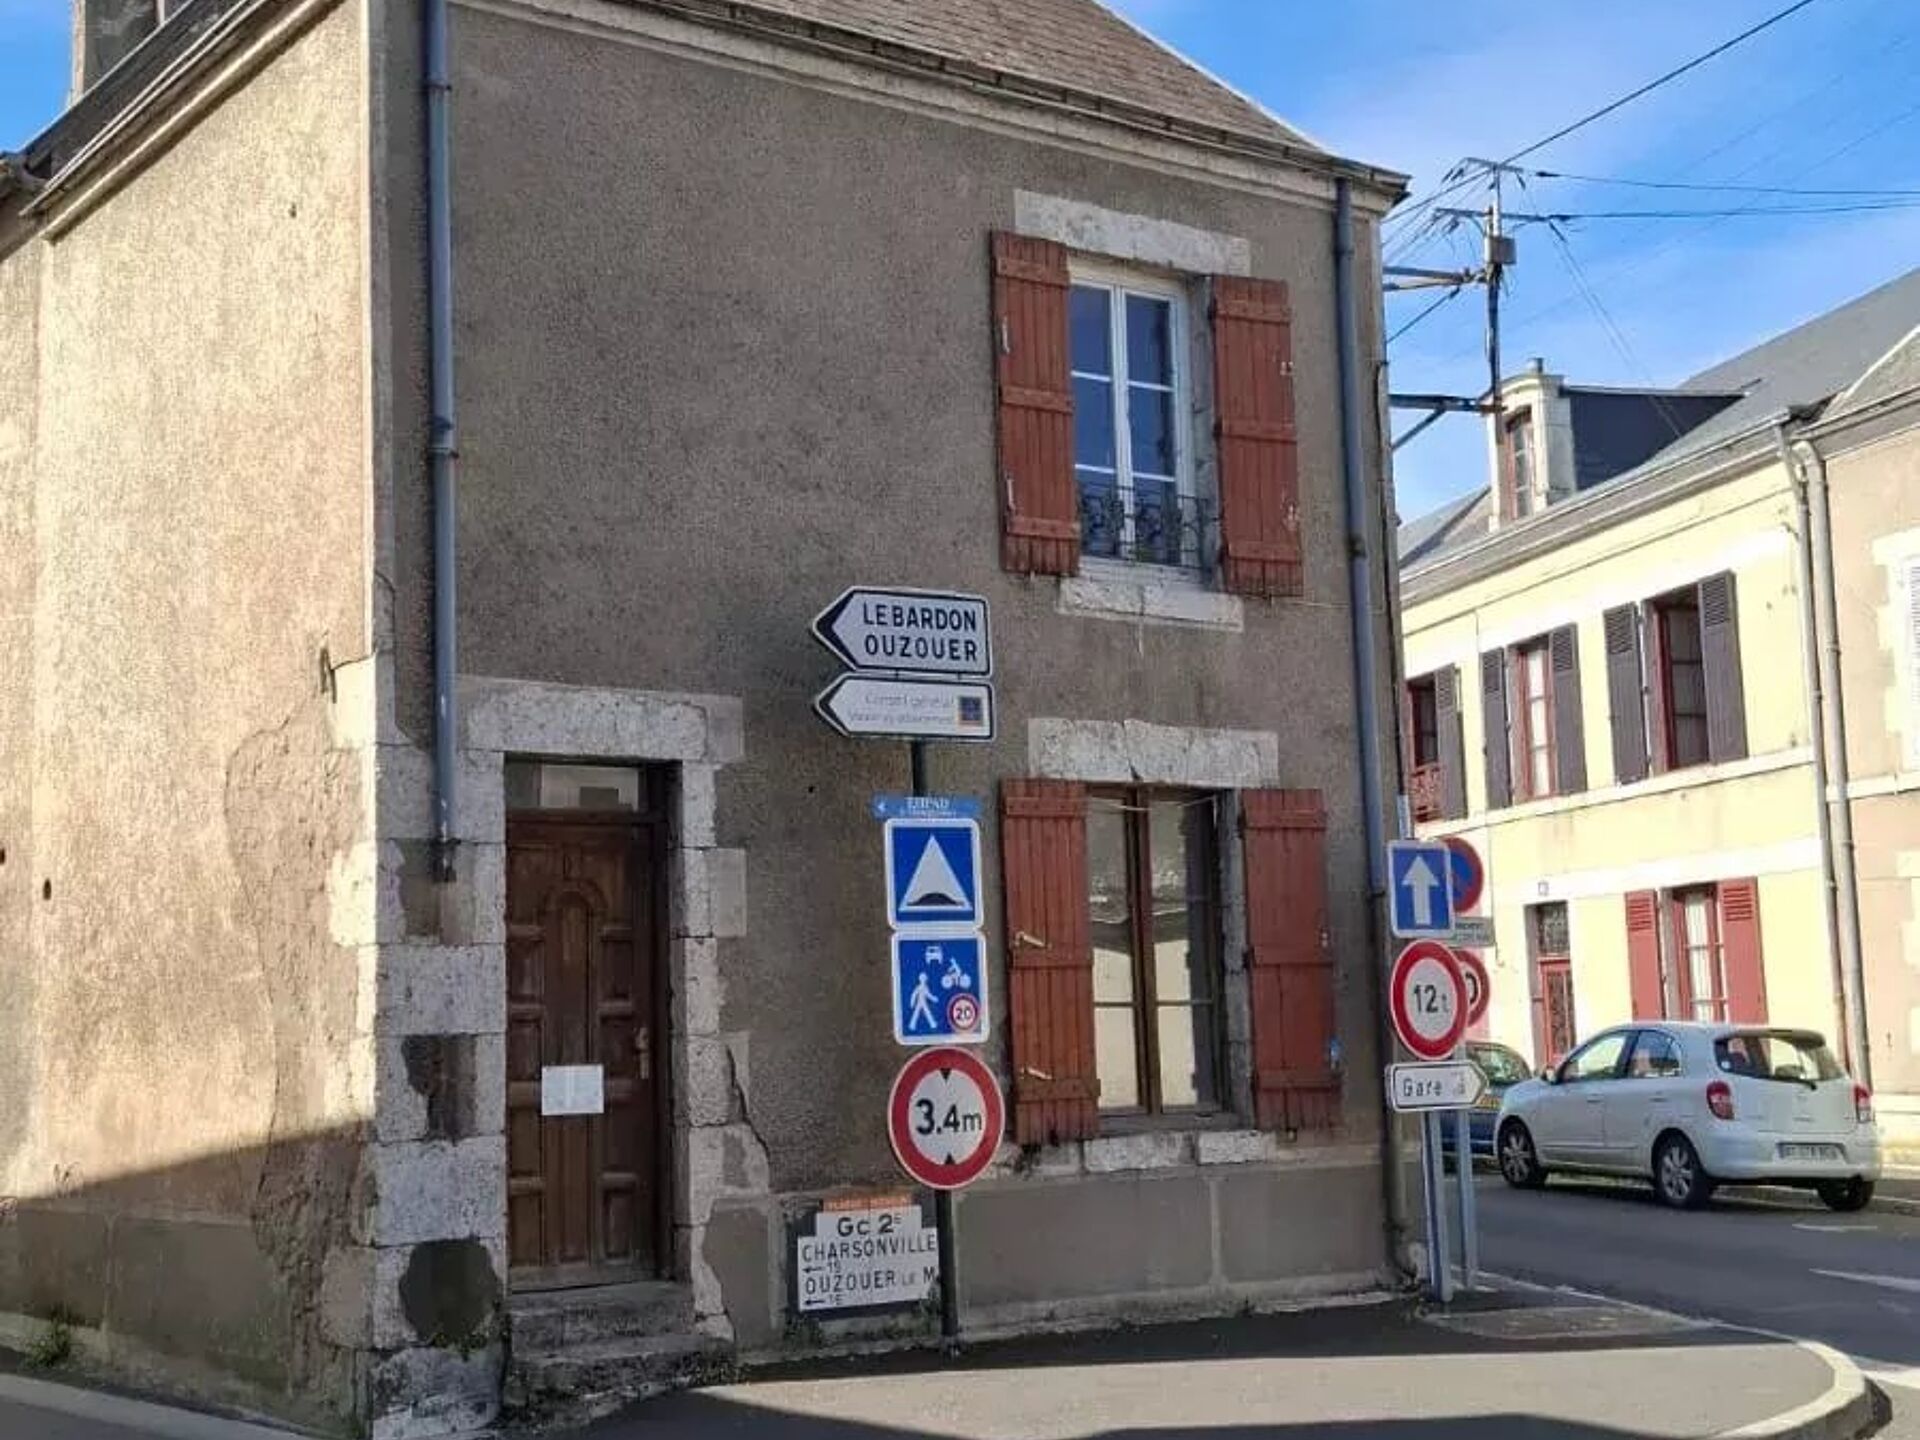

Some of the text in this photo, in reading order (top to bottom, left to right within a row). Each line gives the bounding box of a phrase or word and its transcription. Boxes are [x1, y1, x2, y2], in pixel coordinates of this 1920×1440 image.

[863, 601, 977, 632] LE BARDON
[864, 634, 978, 662] OUZOUER
[955, 1005, 973, 1021] 20
[1403, 1077, 1442, 1097] Gare
[915, 1099, 983, 1135] 3.4m
[801, 1234, 936, 1263] CHARSONVILLE
[805, 1270, 895, 1295] OUZOUER
